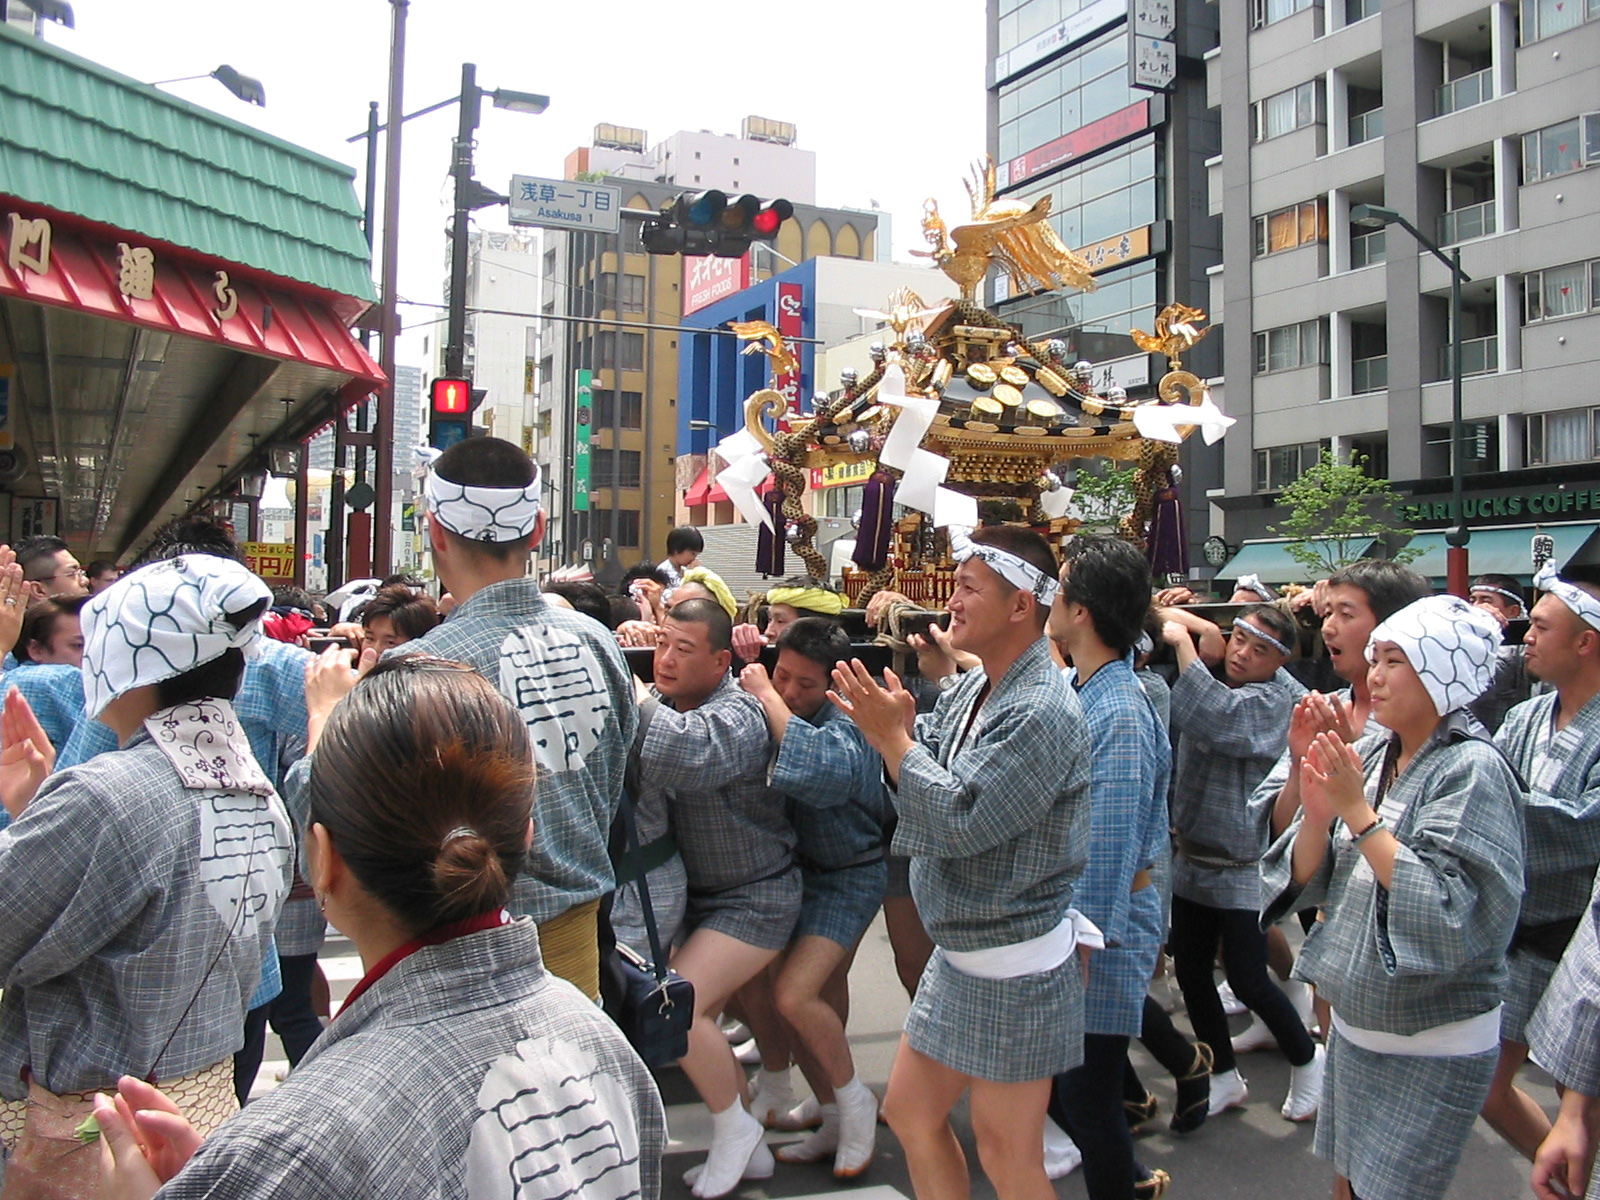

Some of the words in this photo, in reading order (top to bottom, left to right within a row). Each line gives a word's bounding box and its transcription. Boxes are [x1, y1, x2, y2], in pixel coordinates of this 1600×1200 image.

[520, 182, 610, 211] 浅草一丁目
[537, 207, 582, 222] Asakusa
[588, 213, 593, 223] 1
[691, 288, 711, 307] FRESH
[711, 276, 733, 297] FOODS
[1394, 495, 1522, 522] STARUCKS
[1528, 490, 1600, 514] COFFE
